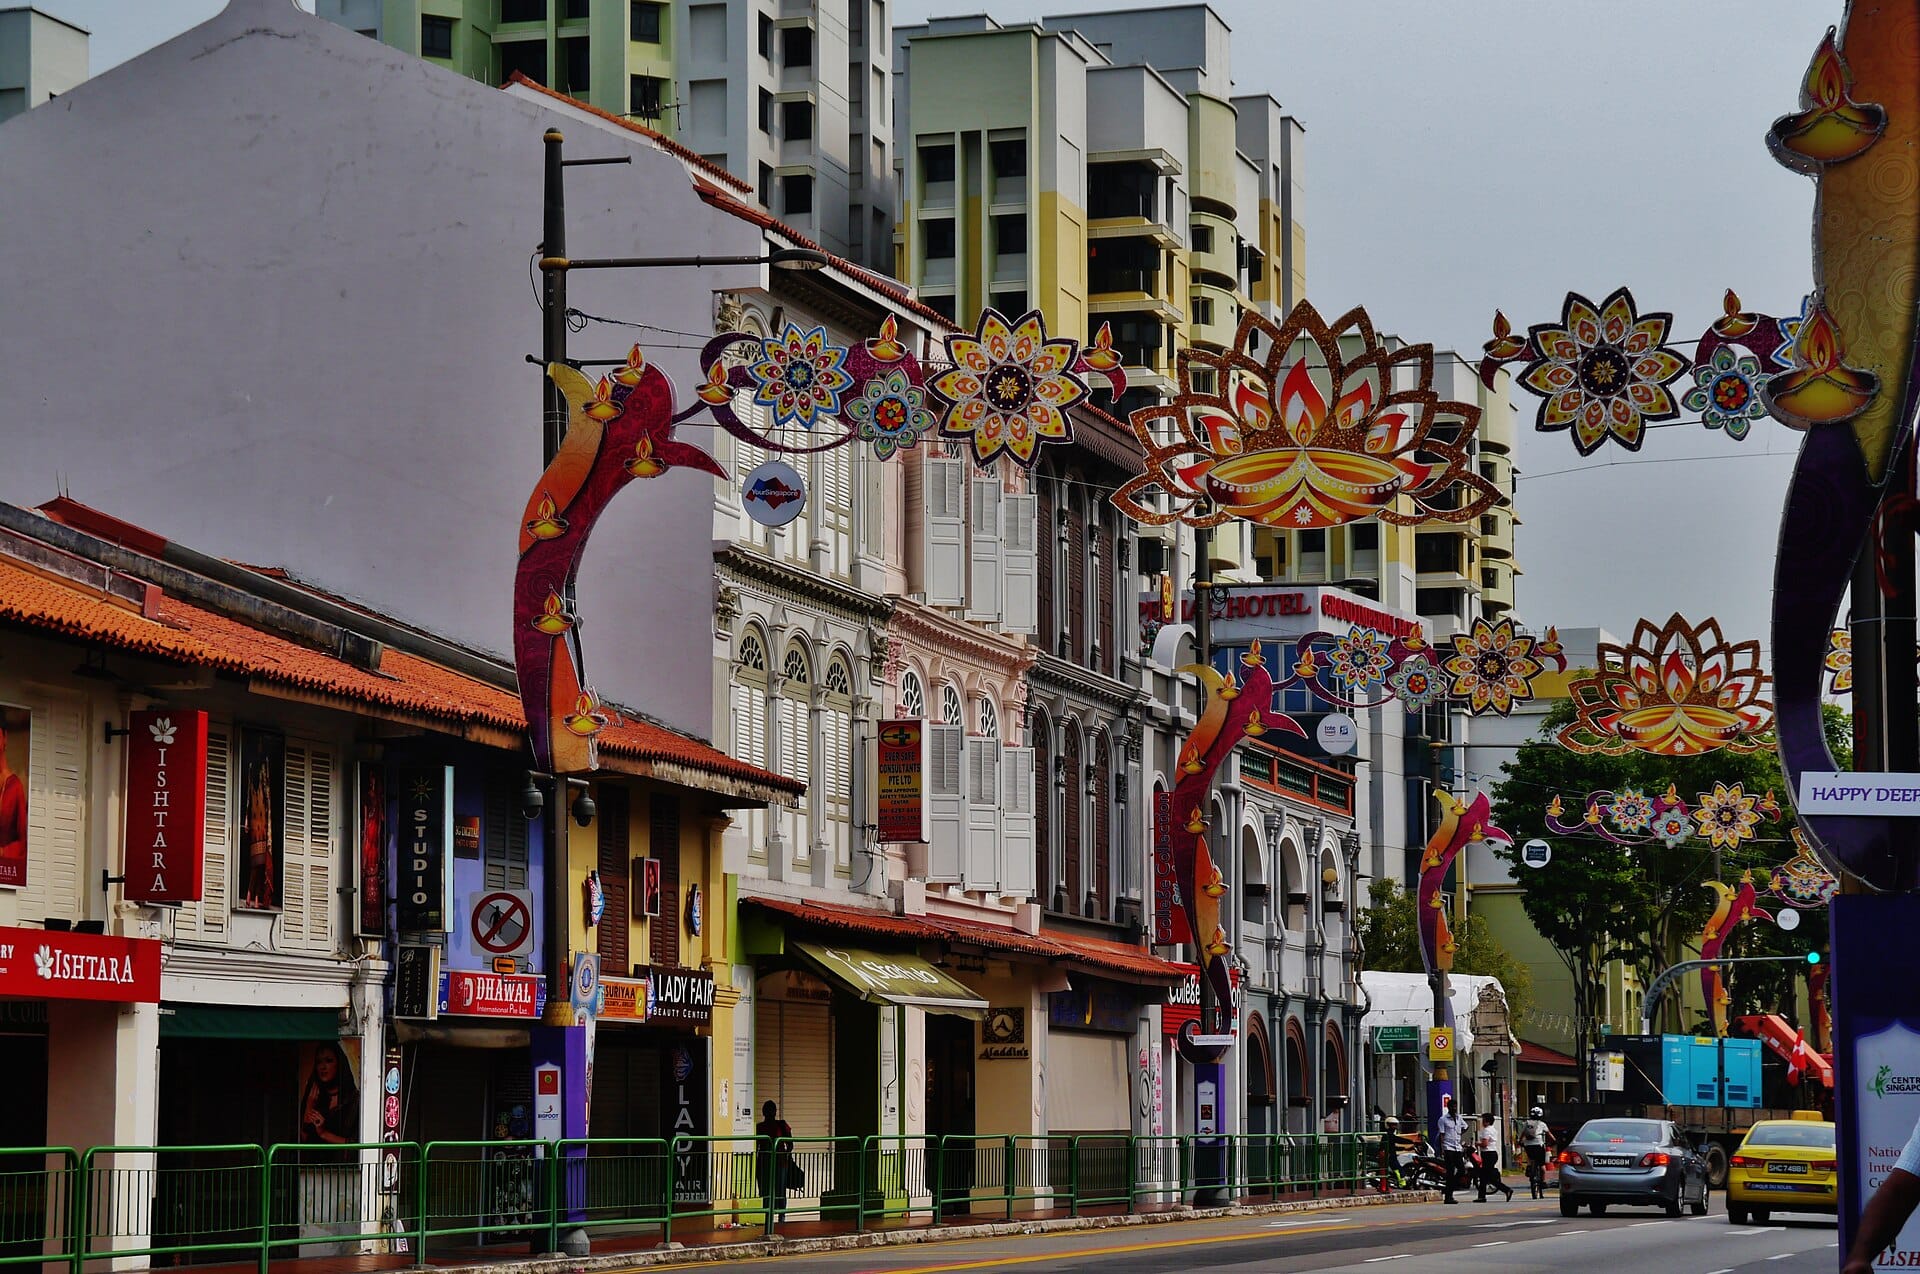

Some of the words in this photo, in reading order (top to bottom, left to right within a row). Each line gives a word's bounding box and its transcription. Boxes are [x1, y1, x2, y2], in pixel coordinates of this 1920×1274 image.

[1226, 593, 1312, 618] HOTEL
[1321, 594, 1355, 623] GRAND
[880, 764, 921, 774] CONSULTANTS
[888, 775, 900, 785] PTE
[901, 775, 912, 785] LTD
[1811, 787, 1872, 801] HAPPY
[150, 747, 169, 893] ISHTARA
[411, 808, 428, 905] STUDIO
[53, 949, 135, 984] ISHTARA
[475, 976, 531, 1004] DHAWAL
[605, 984, 636, 999] SURIYAA
[658, 973, 688, 1004] LADY
[690, 977, 714, 1007] FAIR
[476, 1002, 509, 1014] International
[653, 1006, 680, 1017] BEAUTY
[682, 1008, 708, 1020] CENTER
[979, 1047, 1029, 1060] Aladdin's
